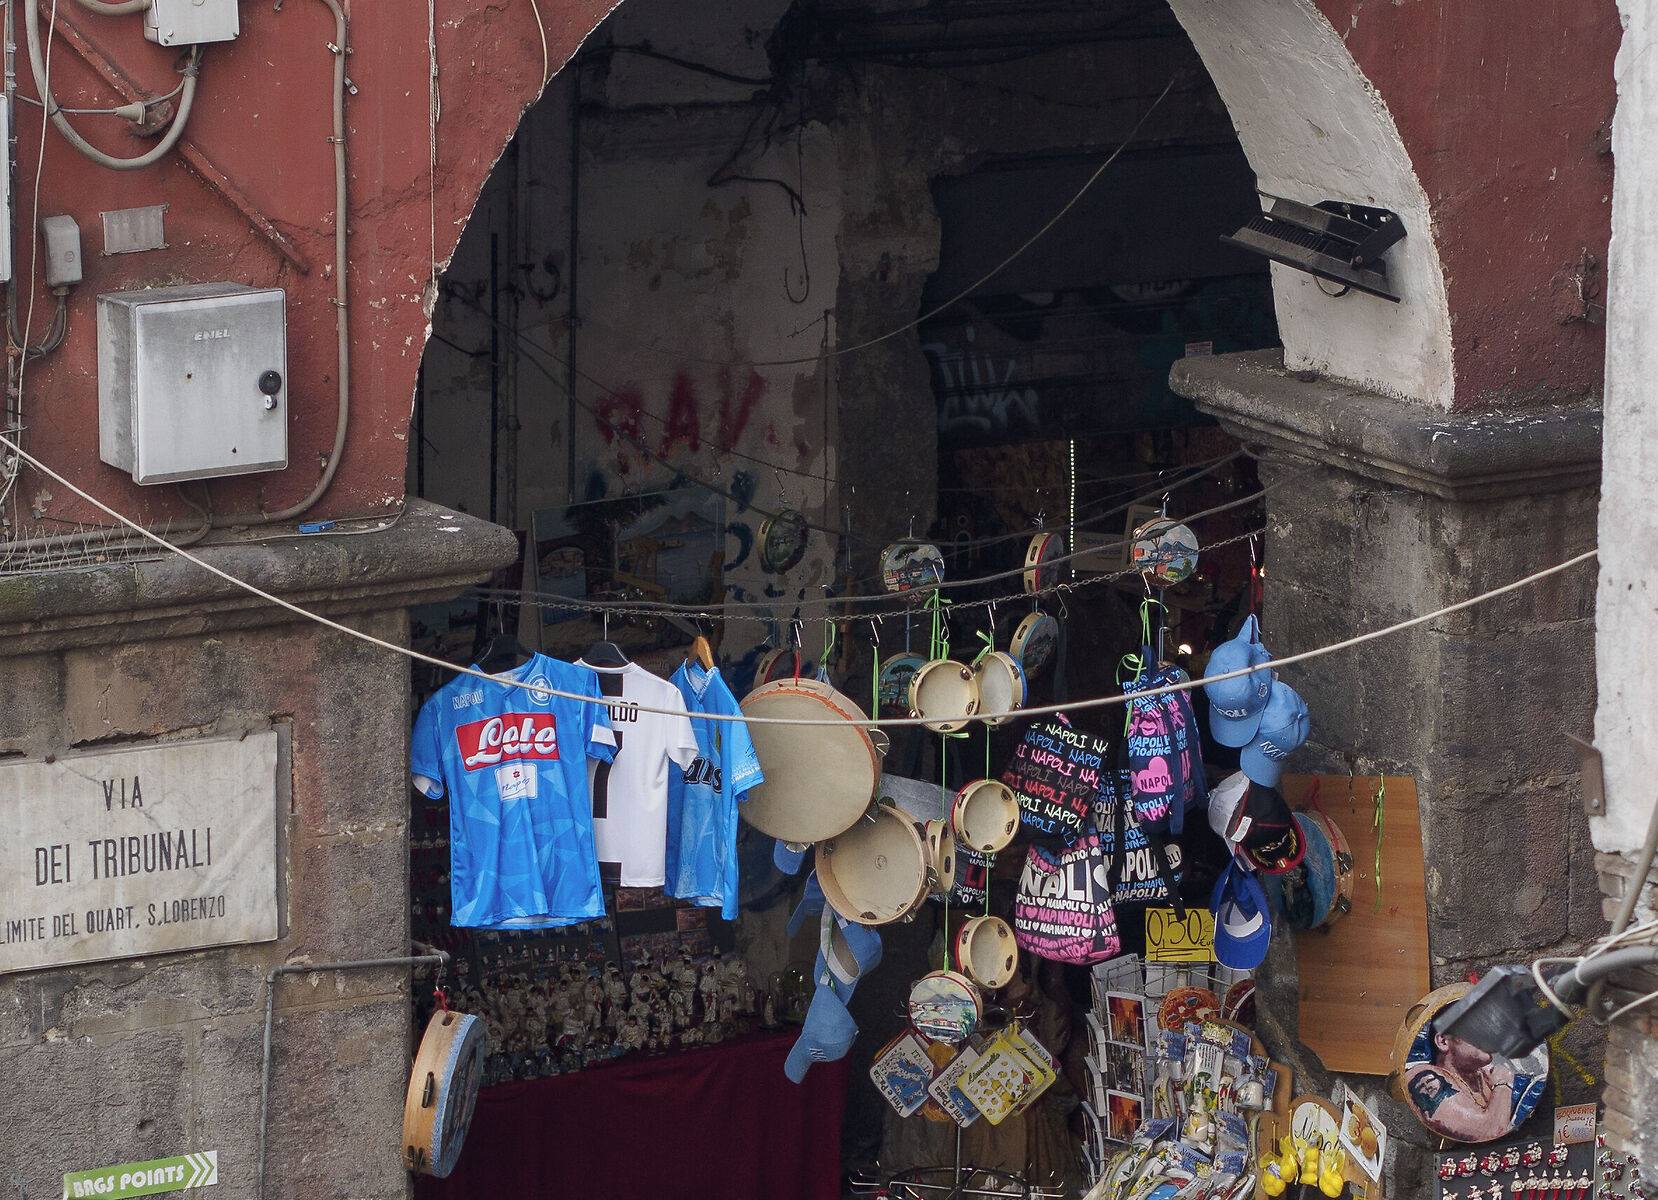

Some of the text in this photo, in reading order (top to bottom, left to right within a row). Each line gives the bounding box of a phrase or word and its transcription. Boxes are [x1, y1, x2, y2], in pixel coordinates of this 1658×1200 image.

[194, 329, 230, 340] ENEL
[465, 718, 556, 766] Lete
[1025, 730, 1064, 754] NAPOLI
[1045, 724, 1088, 748] NAPOLI
[1030, 749, 1076, 776] NAPOLI
[103, 776, 144, 811] VIA
[1024, 780, 1068, 804] NAPOLI
[1020, 810, 1056, 833] NAPOLI
[35, 828, 212, 886] DEI TRIBUNALI
[53, 912, 79, 938] DEL
[73, 1164, 184, 1198] BAGS POINTS
